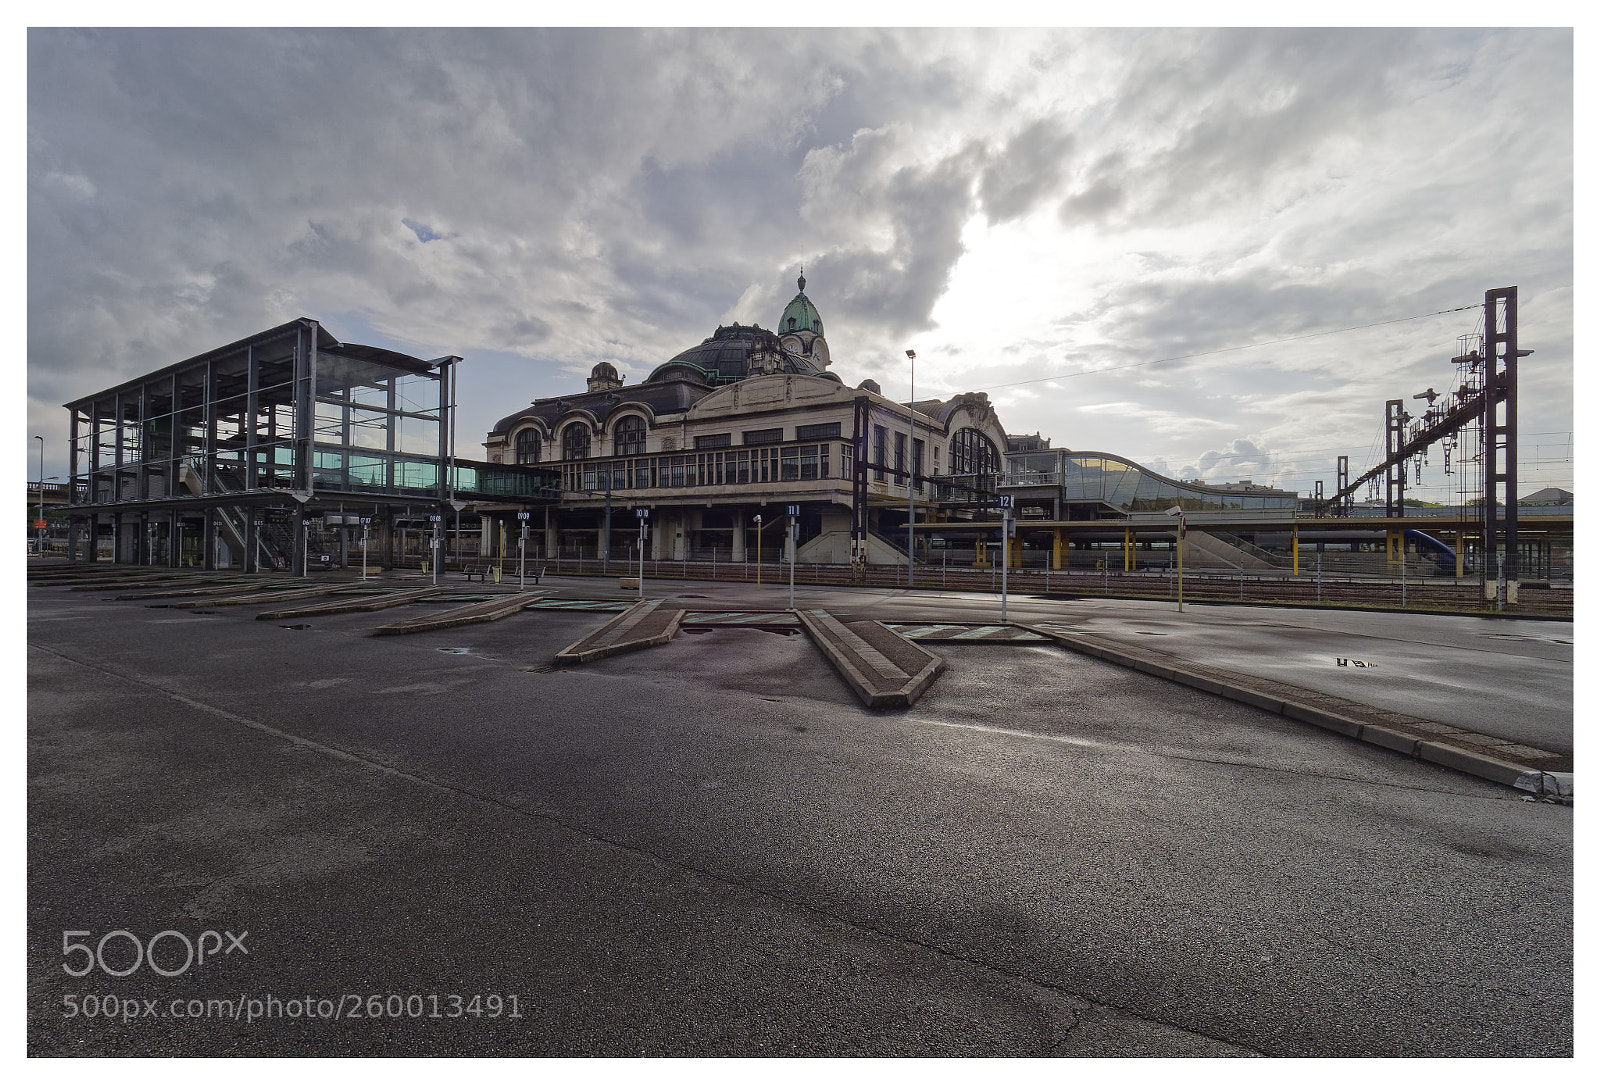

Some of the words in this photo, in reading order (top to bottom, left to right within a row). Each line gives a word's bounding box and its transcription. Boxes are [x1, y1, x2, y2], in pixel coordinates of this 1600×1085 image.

[999, 496, 1009, 507] 12
[636, 509, 643, 517] 10
[788, 505, 795, 515] 11
